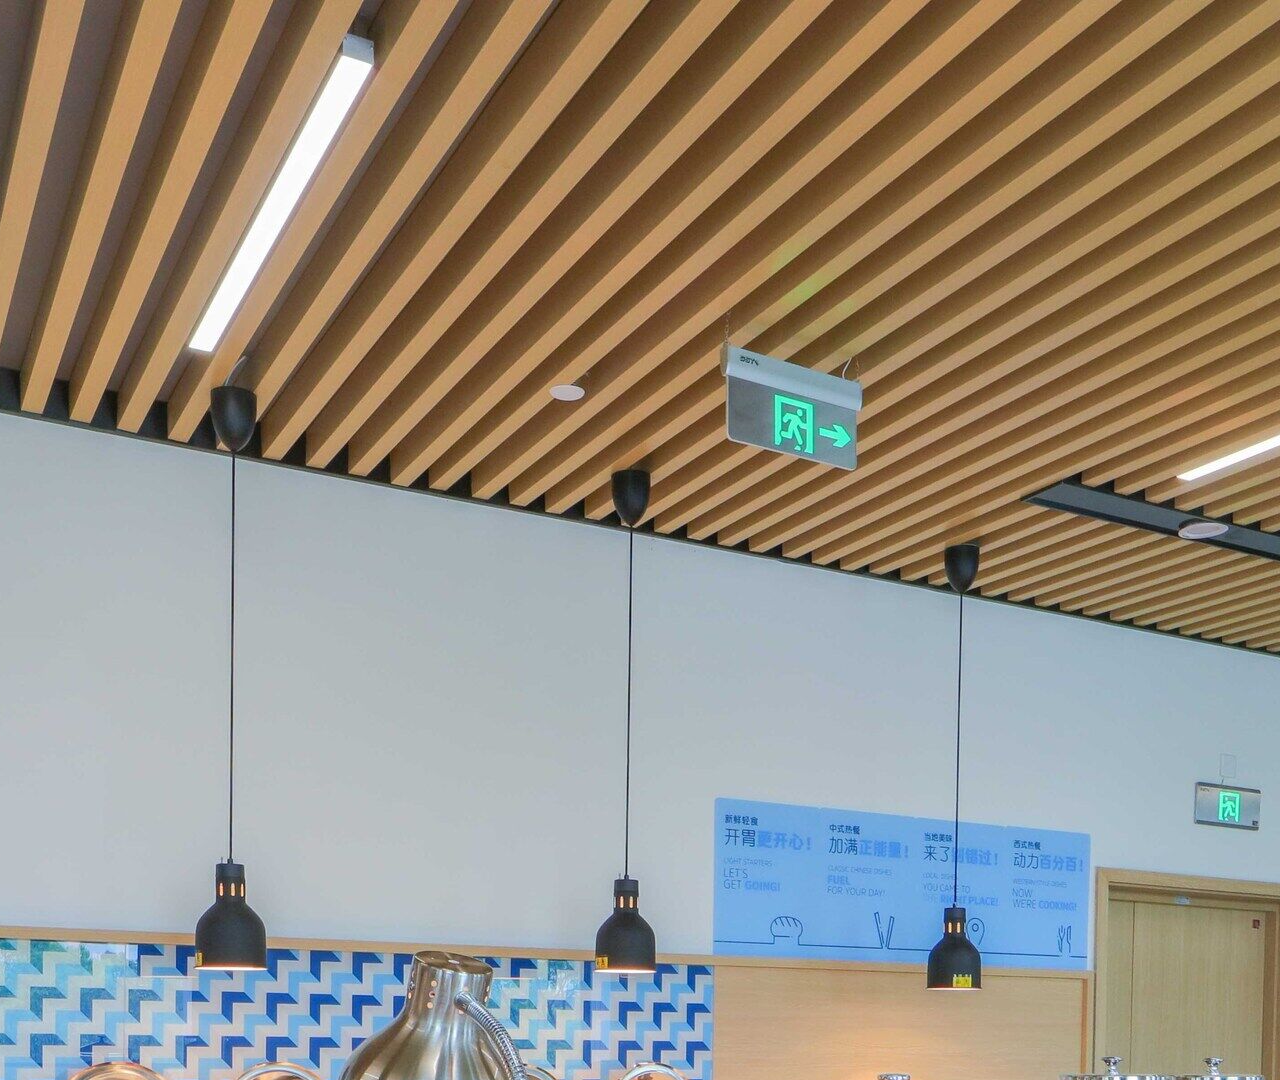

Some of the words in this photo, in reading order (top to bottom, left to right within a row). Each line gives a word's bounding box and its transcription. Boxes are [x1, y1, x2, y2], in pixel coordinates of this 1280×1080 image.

[724, 814, 759, 827] 新鲜轻食
[829, 824, 860, 835] 中式热餐
[723, 879, 742, 890] GET
[827, 875, 851, 886] FUEL
[827, 886, 843, 896] FOR
[845, 887, 867, 897] YOUR
[1012, 888, 1033, 898] NOW
